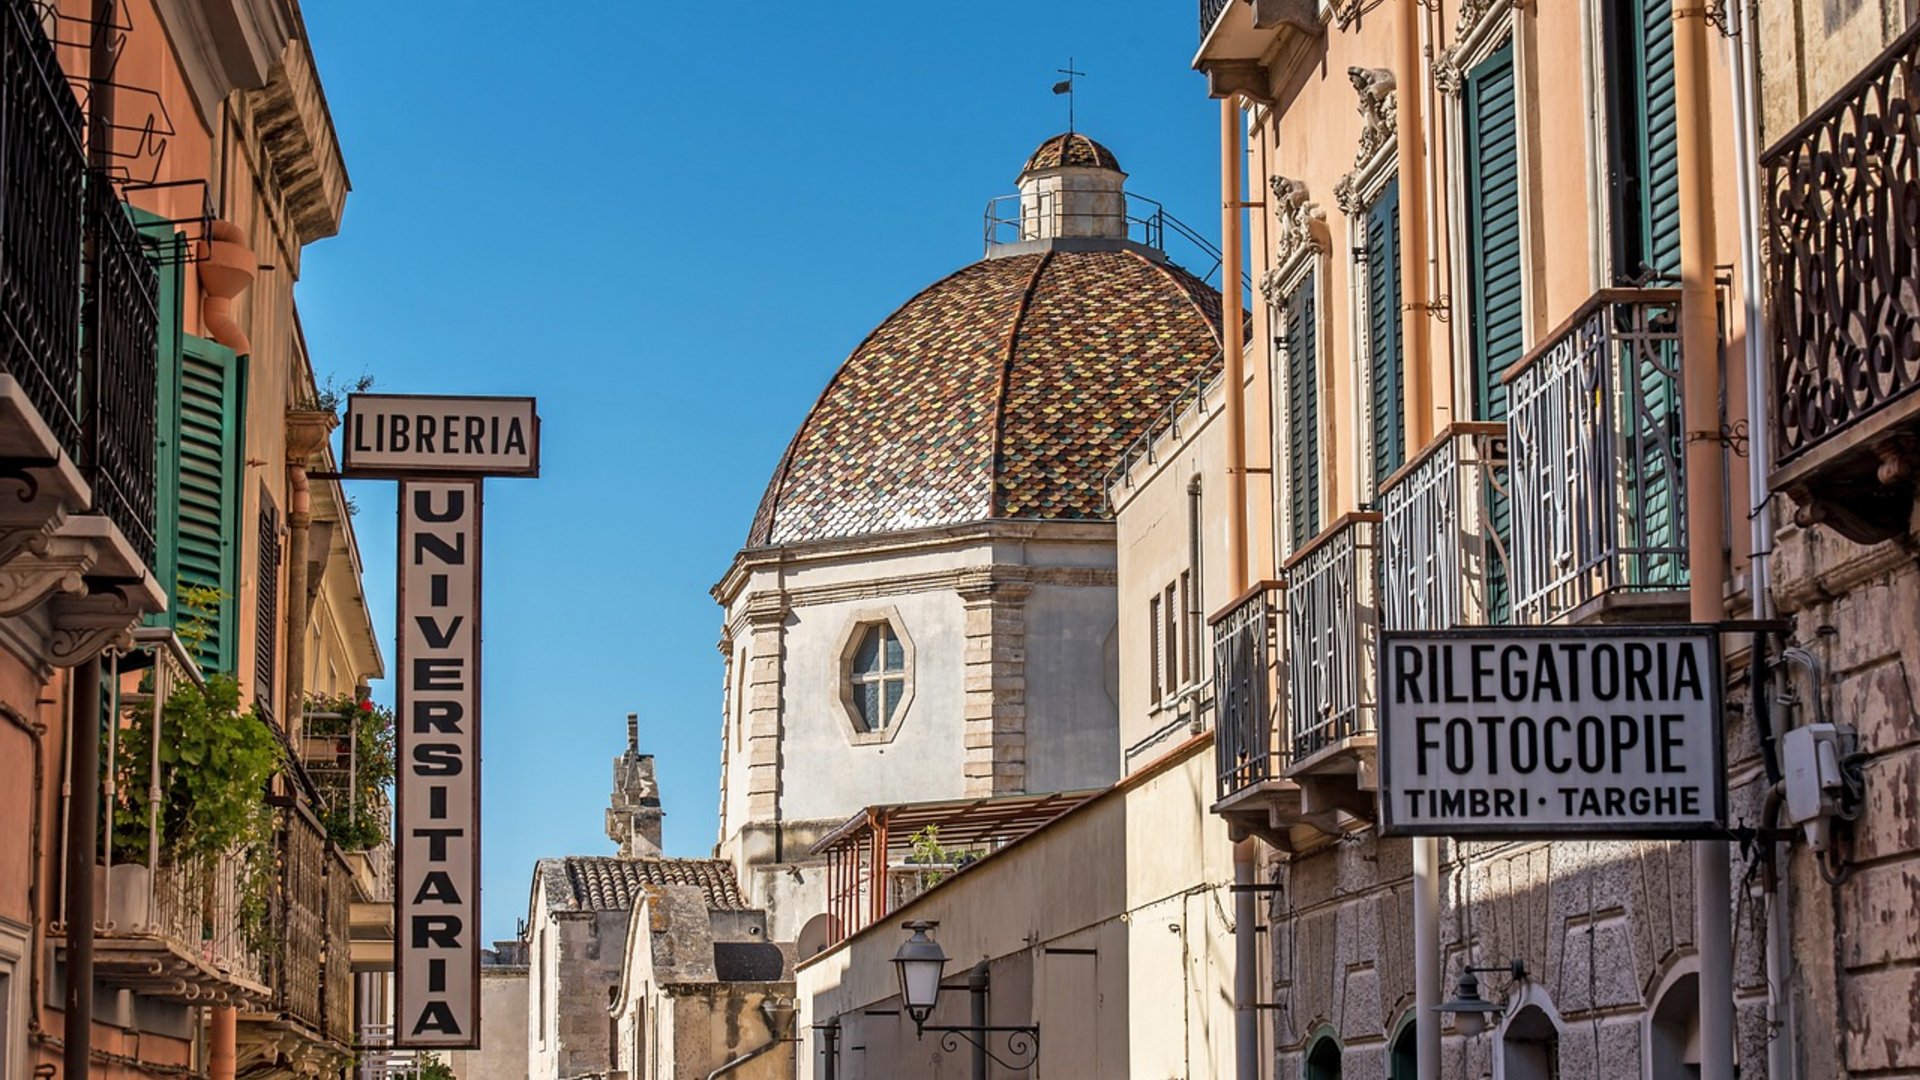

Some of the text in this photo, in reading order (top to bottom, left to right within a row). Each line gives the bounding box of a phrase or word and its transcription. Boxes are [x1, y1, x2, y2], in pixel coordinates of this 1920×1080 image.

[354, 413, 527, 455] LIBRERIA
[1395, 642, 1704, 704] RILEGATORIA
[412, 489, 464, 1036] UNIVERSITARIA
[1416, 713, 1687, 776] FOTOCOPIE
[1404, 788, 1528, 818] TIMBRI
[1558, 786, 1700, 816] TARGHE
